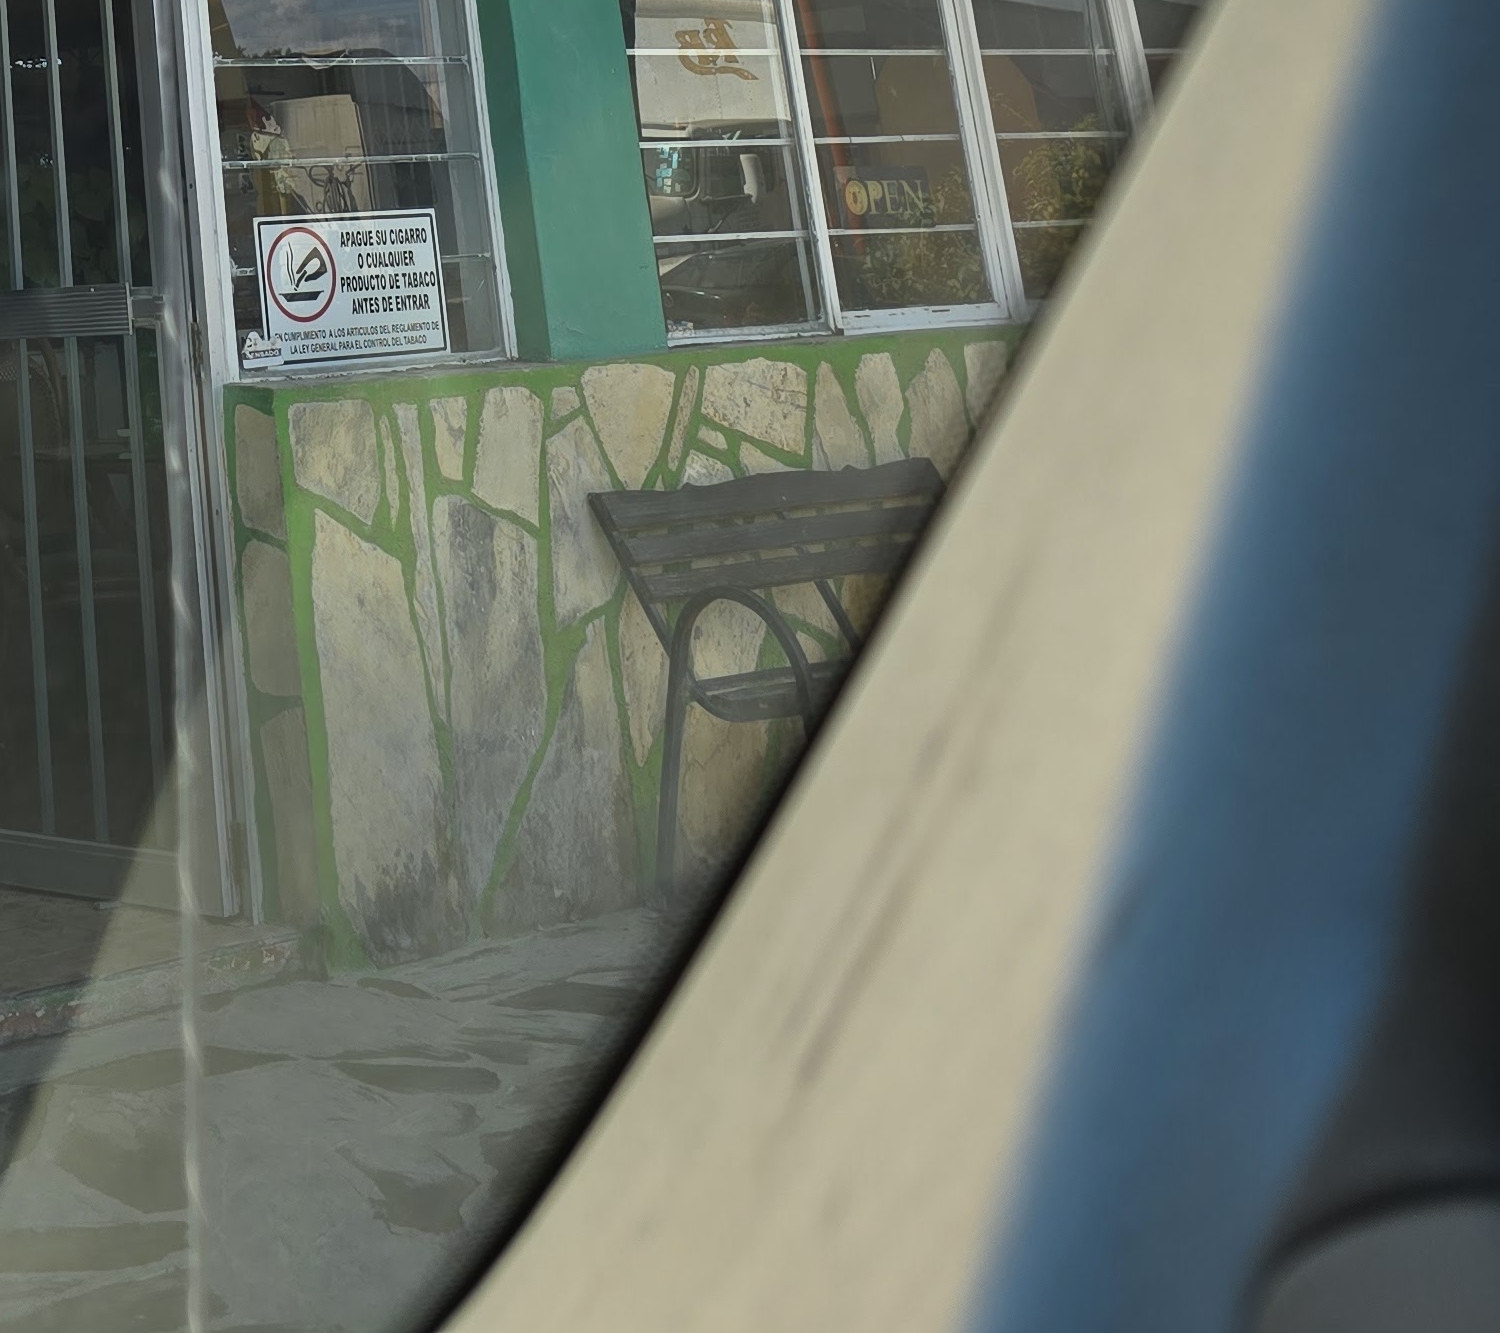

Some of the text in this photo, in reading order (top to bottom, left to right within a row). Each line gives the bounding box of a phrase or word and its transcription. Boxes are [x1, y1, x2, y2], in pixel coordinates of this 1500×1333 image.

[845, 179, 925, 215] OPEN
[340, 227, 428, 248] APAGUE SU CIGARRO
[357, 250, 416, 269] O CUALQUIER
[340, 271, 436, 293] PRODUCTO DE TABACO
[352, 293, 431, 315] ANTES DE ENTRAR
[284, 329, 327, 342] CUMPLIMIENTO
[333, 327, 346, 337] LOS
[346, 325, 379, 337] ARTICULOS
[379, 324, 391, 335] DEL
[391, 321, 431, 334] REGLAMENTO
[431, 321, 440, 331] DE
[290, 334, 427, 355] LA LEY GENERAL PARA EL CONTROL DEL TABACO
